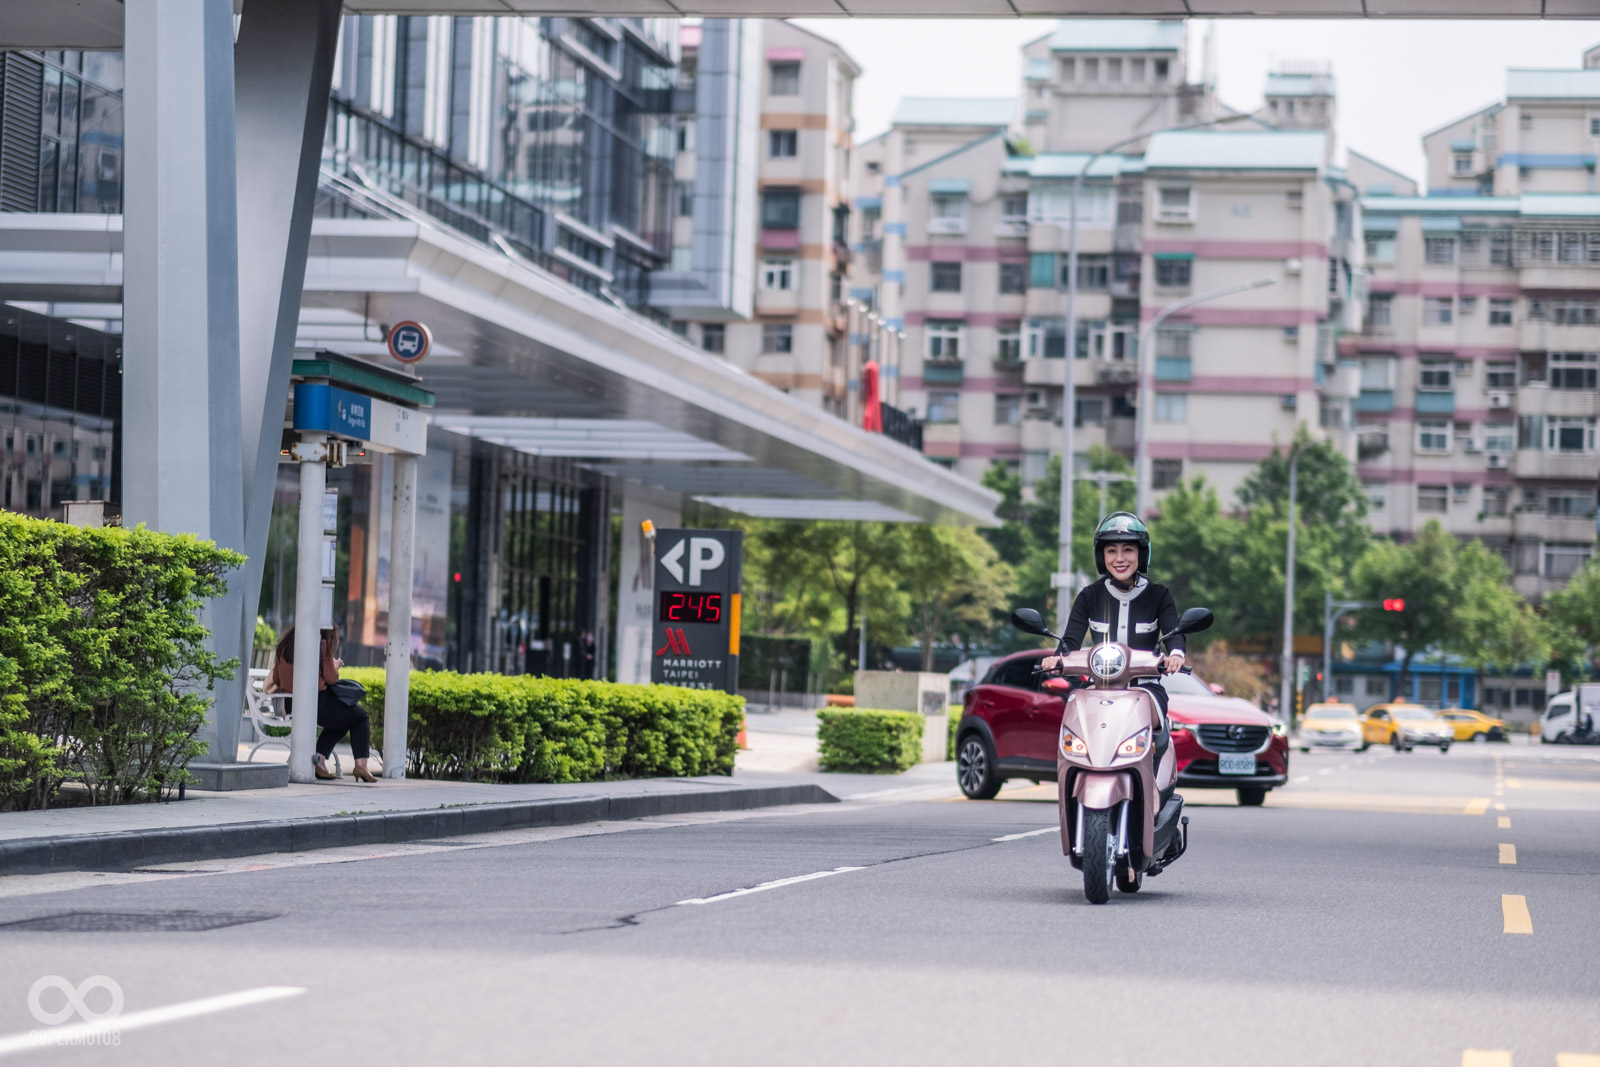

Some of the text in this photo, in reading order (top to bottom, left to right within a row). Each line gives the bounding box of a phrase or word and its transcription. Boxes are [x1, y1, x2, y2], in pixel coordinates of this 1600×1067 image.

[689, 537, 725, 586] P
[669, 594, 721, 621] 245
[663, 659, 722, 669] MARRIOTT
[663, 669, 699, 679] TAIPEI
